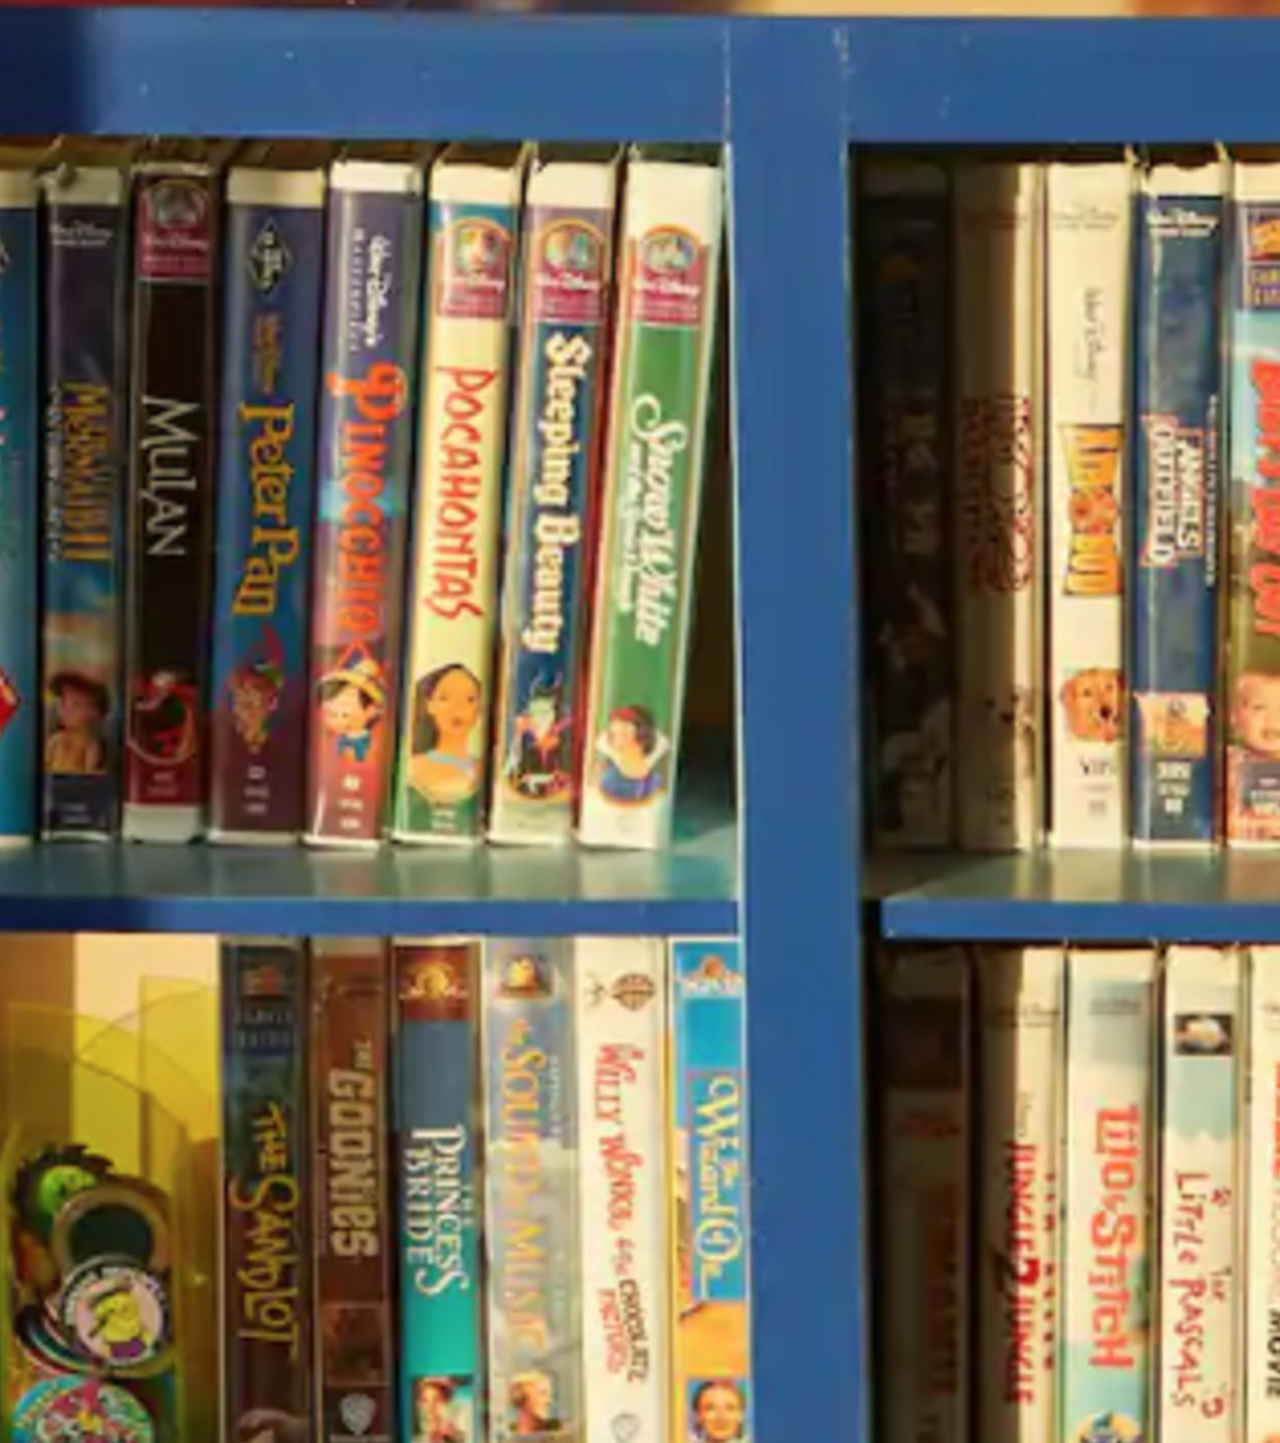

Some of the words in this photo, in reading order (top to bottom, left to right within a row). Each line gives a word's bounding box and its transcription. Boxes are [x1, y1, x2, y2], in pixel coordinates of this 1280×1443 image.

[236, 400, 298, 527] Peter
[534, 331, 593, 506] Sleeping
[630, 393, 689, 524] Snow
[325, 358, 408, 636] PINOCCHIO
[423, 365, 498, 621] POCAHONTAS
[1173, 437, 1204, 550] ANGELS
[229, 525, 302, 615] Pan
[522, 513, 582, 654] Beauty
[633, 522, 679, 648] White
[253, 1100, 289, 1172] THE
[327, 1067, 380, 1260] GOONIES
[1003, 1139, 1039, 1253] JUNGLE
[1096, 1102, 1142, 1193] LILO
[228, 1171, 302, 1362] SANDLOT
[404, 1147, 435, 1265] BRIDE
[412, 1124, 471, 1297] PRINCESS
[992, 1248, 1041, 1295] 2
[1088, 1210, 1140, 1371] STITCH
[1002, 1293, 1037, 1407] JUNGLE
[1168, 1278, 1208, 1409] RASCALS
